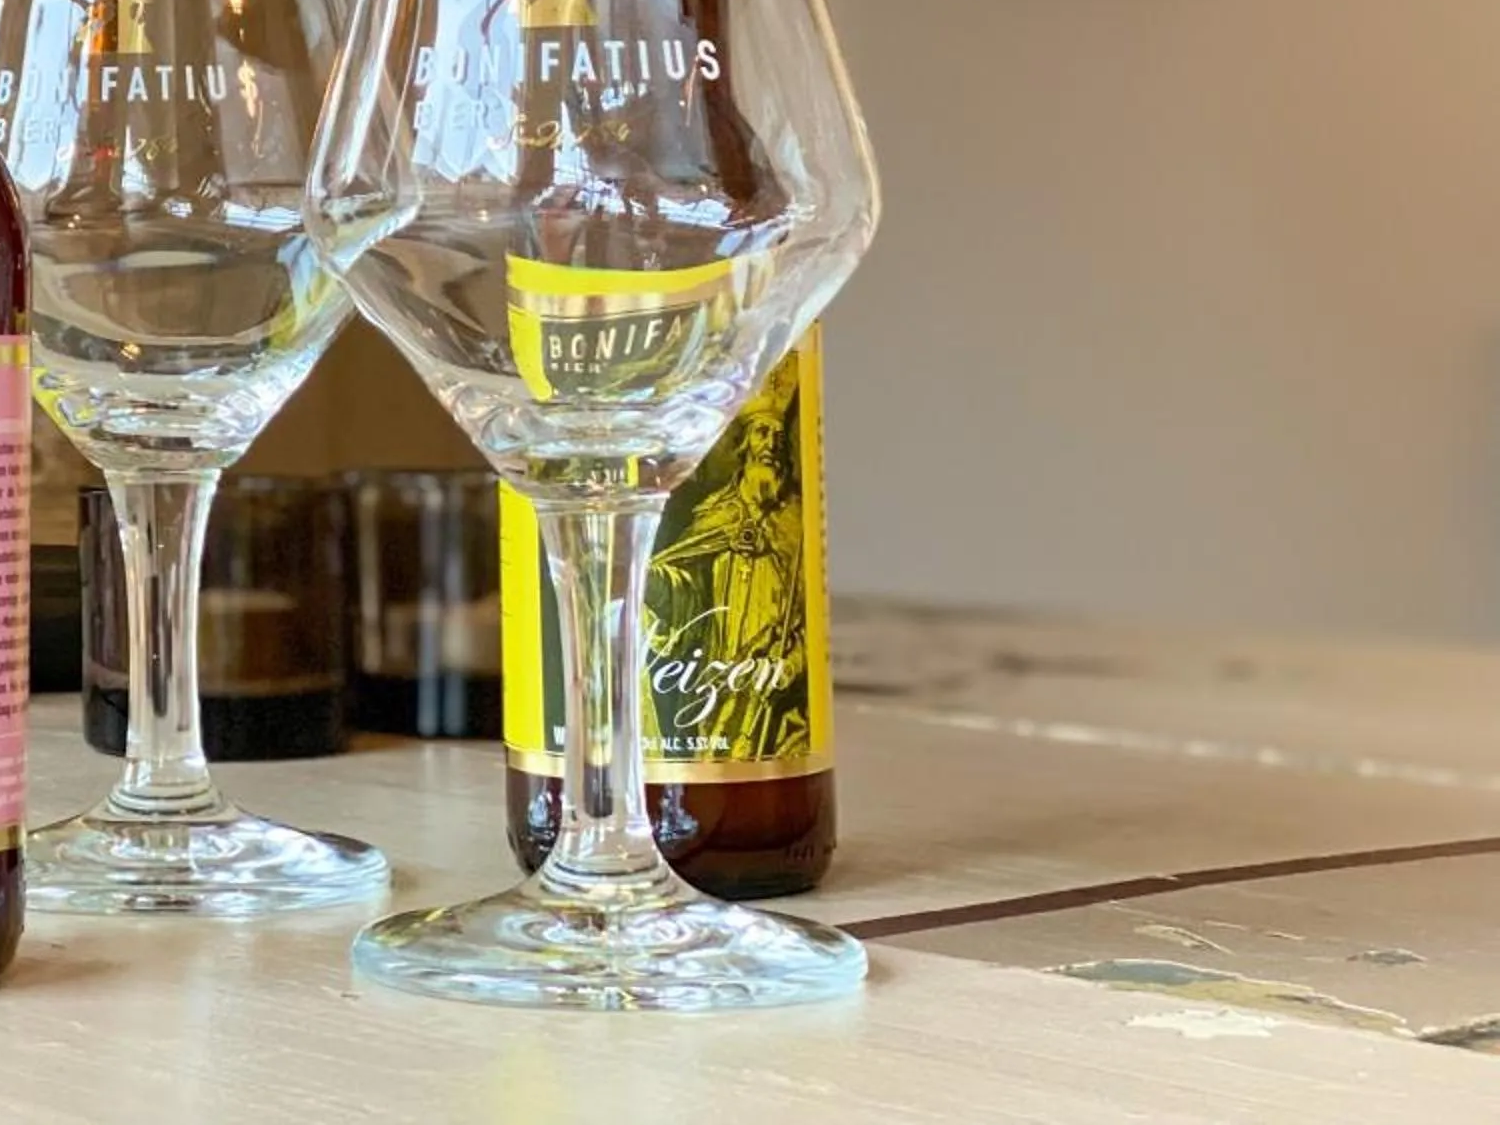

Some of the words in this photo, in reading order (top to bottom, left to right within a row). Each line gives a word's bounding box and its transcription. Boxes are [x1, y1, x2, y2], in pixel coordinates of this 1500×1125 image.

[413, 39, 721, 87] BONIFATIUS
[414, 101, 491, 129] BER
[549, 316, 681, 361] BONIFA
[647, 606, 796, 728] eizen
